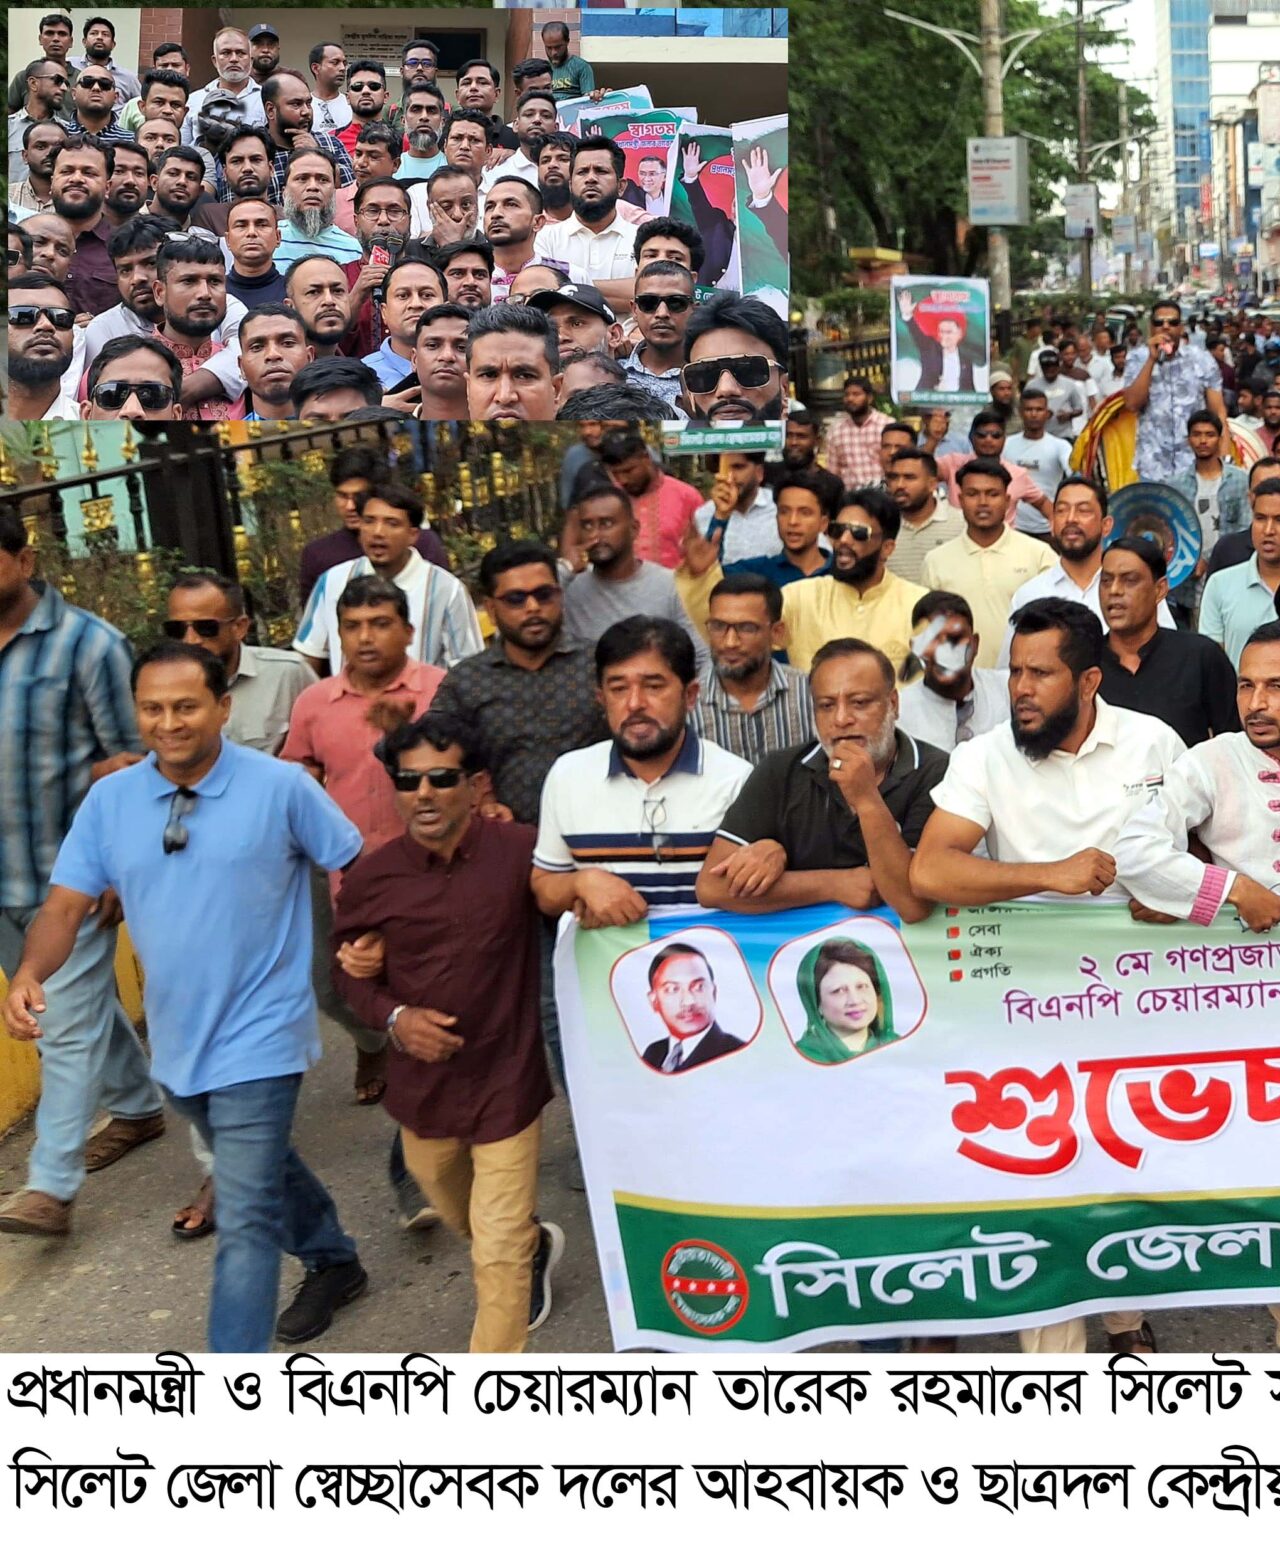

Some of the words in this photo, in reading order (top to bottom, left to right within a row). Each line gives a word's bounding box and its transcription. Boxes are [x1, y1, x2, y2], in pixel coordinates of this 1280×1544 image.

[628, 123, 676, 137] স্বাগতম
[968, 924, 1002, 937] সেবা
[1079, 956, 1103, 981] ২
[1115, 951, 1152, 976] মে
[1003, 985, 1123, 1025] বিএনপি
[754, 1225, 1051, 1318] সিলেট
